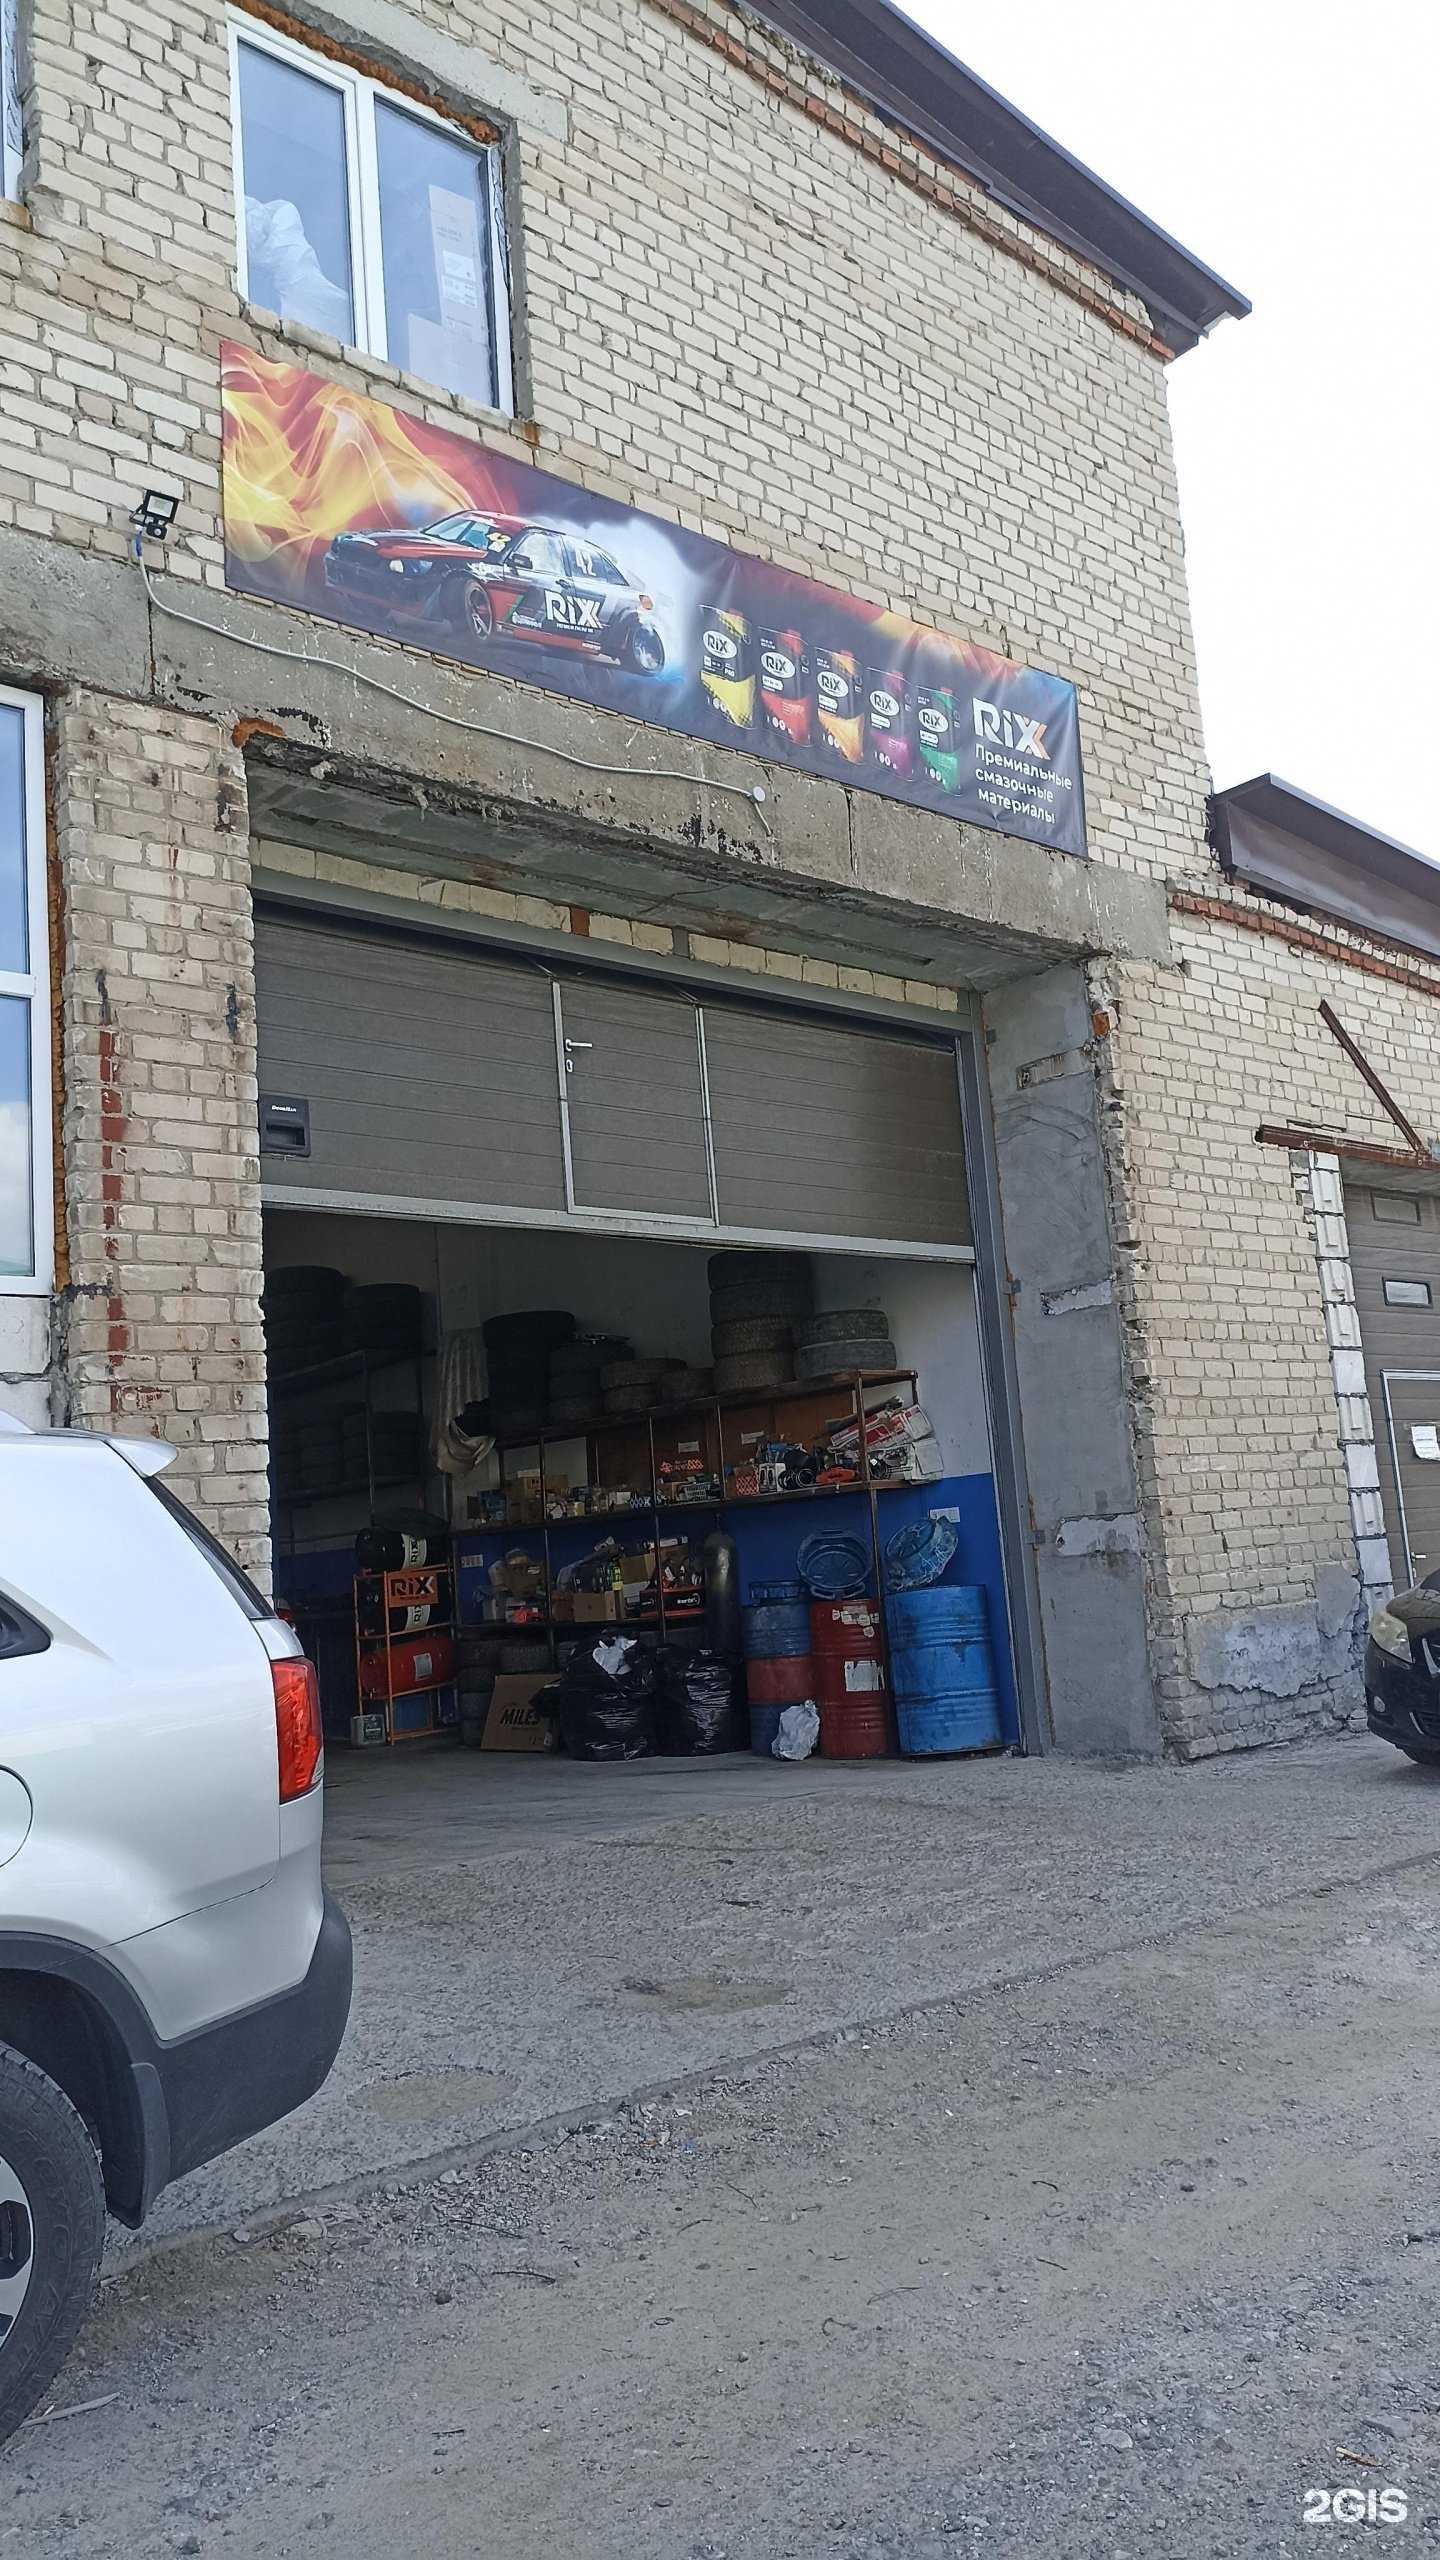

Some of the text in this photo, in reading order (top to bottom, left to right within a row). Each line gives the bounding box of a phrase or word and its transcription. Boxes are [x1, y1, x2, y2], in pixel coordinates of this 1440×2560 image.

[975, 743, 1073, 790] Премиальные
[975, 768, 1054, 802] смазочные
[978, 788, 1055, 824] материалы
